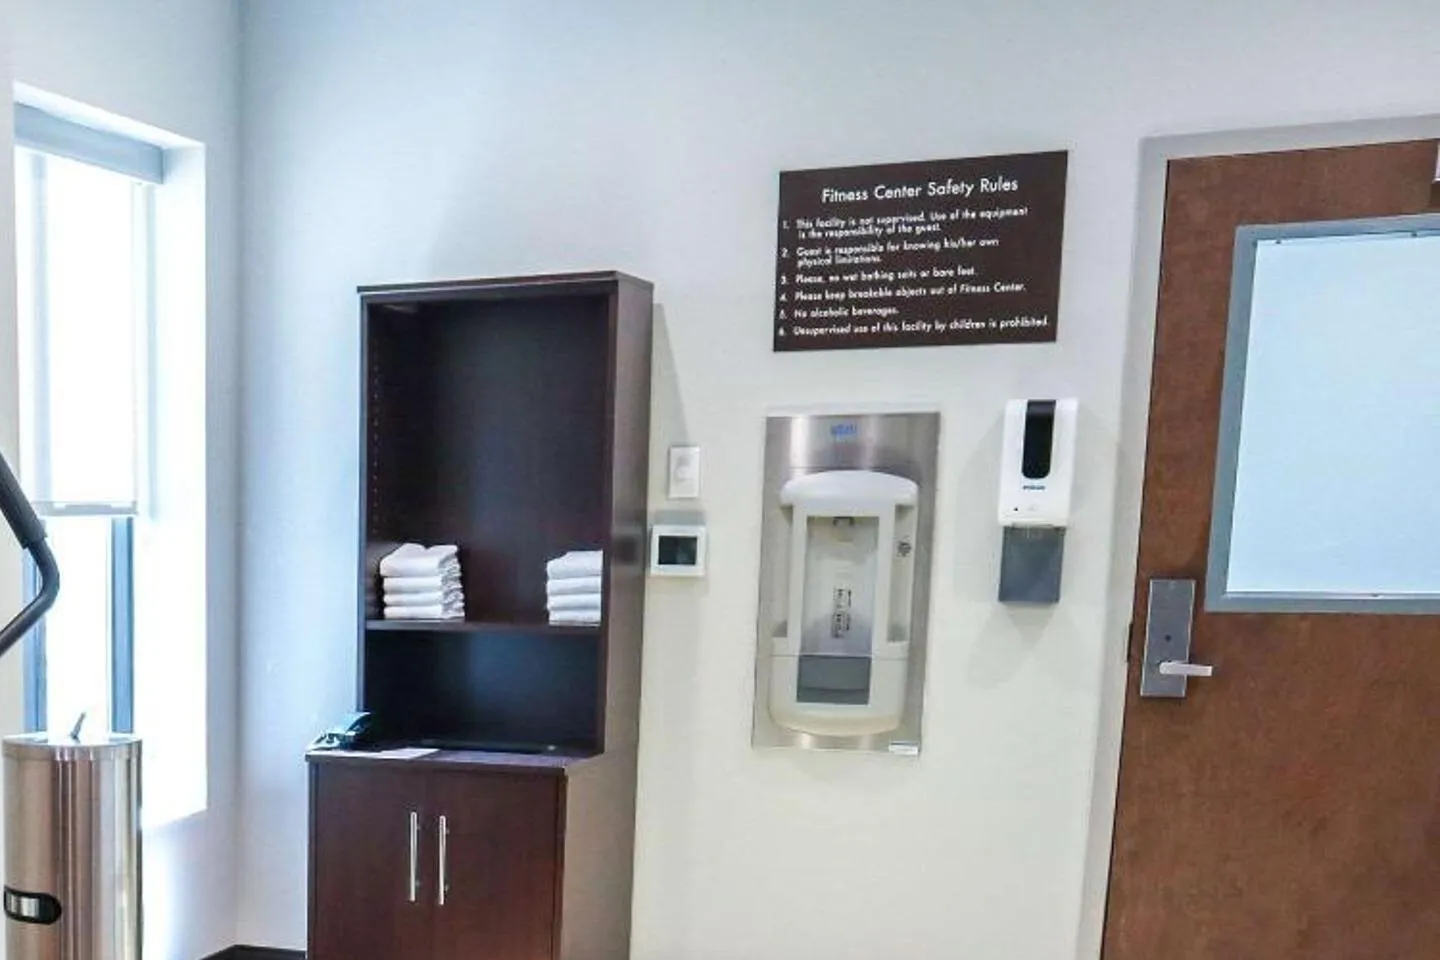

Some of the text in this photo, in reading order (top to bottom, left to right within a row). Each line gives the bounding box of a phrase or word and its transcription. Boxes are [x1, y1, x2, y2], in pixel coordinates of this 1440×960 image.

[821, 176, 1019, 203] Fitness Center Safety Rules
[796, 219, 814, 229] This
[815, 217, 846, 229] facility
[848, 217, 857, 226] is
[859, 216, 874, 225] not
[929, 212, 947, 221] Use
[949, 209, 960, 220] of
[961, 208, 976, 219] the
[979, 206, 1028, 220] equipment
[807, 228, 823, 238] the
[824, 223, 882, 237] responsibility
[885, 222, 896, 234] of
[897, 222, 913, 233] the
[796, 246, 822, 257] Guest
[833, 242, 885, 256] responsible
[885, 240, 901, 251] for
[902, 238, 942, 252] knowing
[978, 239, 1001, 247] own
[797, 255, 833, 268] physical
[827, 274, 841, 282] no
[841, 272, 860, 281] wet
[860, 269, 896, 282] bathing
[897, 269, 918, 280] suits
[919, 270, 931, 278] or
[932, 267, 956, 277] bare
[794, 291, 823, 301] Please
[824, 288, 847, 301] keep
[847, 287, 893, 299] breakable
[895, 286, 927, 299] objects
[929, 286, 946, 296] out
[947, 283, 958, 295] of
[959, 283, 991, 293] Fitness
[794, 309, 808, 319] No
[809, 306, 850, 318] alcoholic
[793, 323, 852, 338] Unsupervised
[852, 325, 869, 334] use
[870, 321, 881, 333] of
[881, 321, 899, 332] this
[900, 319, 933, 332] facility
[934, 319, 947, 333] by
[949, 317, 987, 330] children
[988, 317, 998, 327] is
